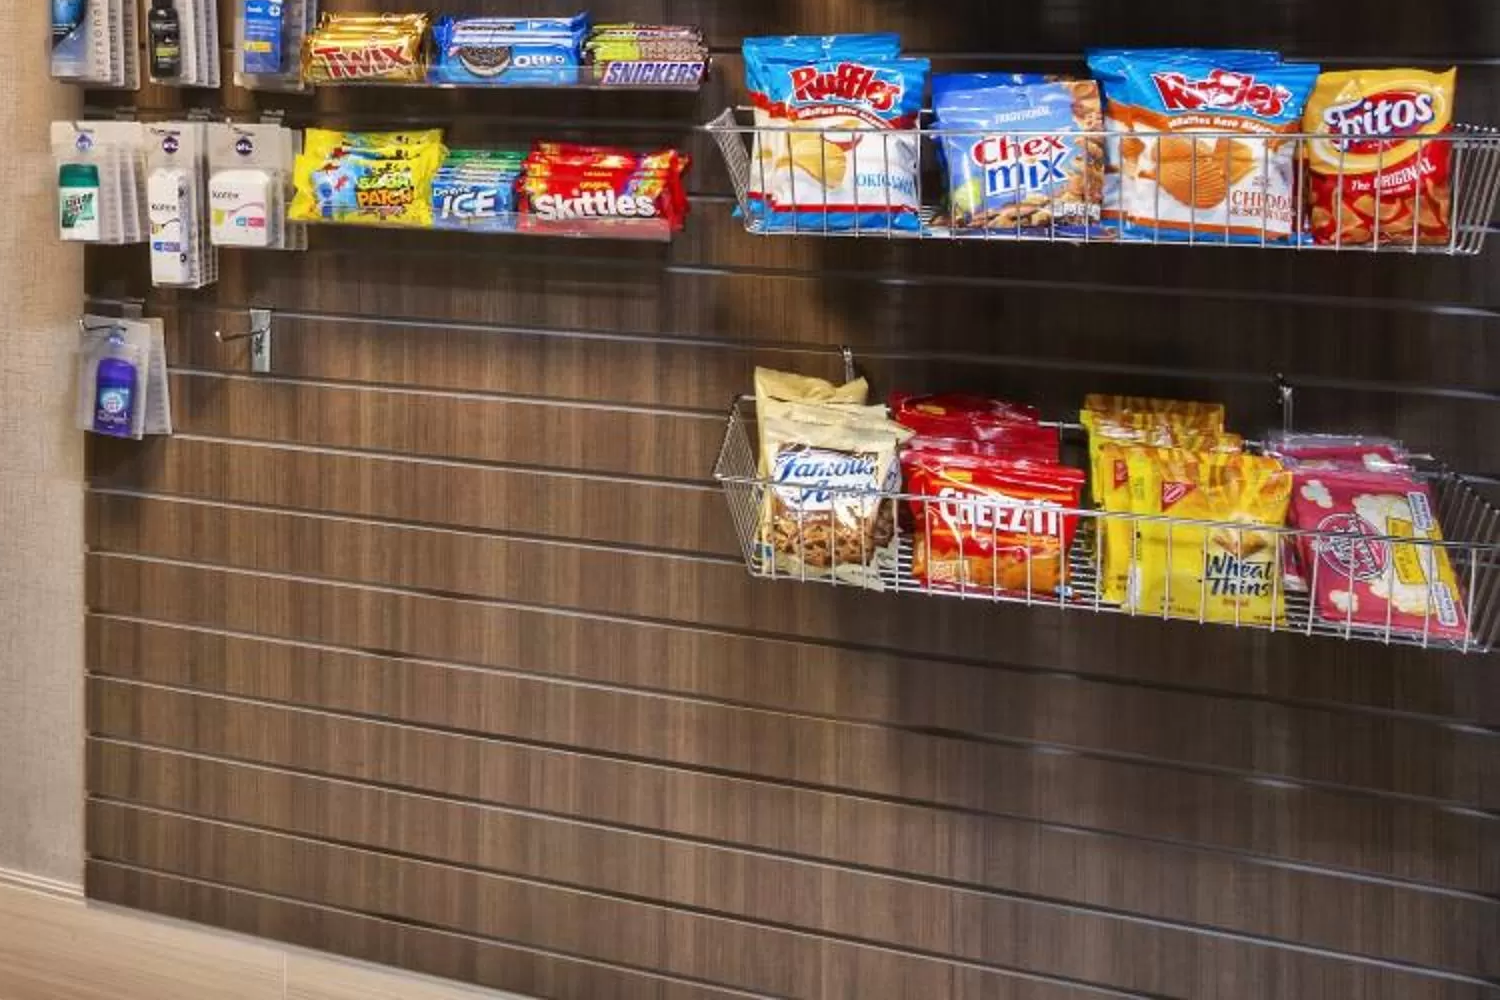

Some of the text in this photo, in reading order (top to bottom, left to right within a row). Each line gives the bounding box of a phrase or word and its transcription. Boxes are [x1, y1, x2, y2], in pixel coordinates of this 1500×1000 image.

[604, 61, 702, 83] SNICKERS
[790, 63, 900, 111] Ruffles
[1322, 91, 1435, 152] Fritos
[972, 133, 1066, 166] Chex
[986, 147, 1067, 195] mix
[440, 189, 497, 218] ICE
[534, 188, 657, 221] Skittles
